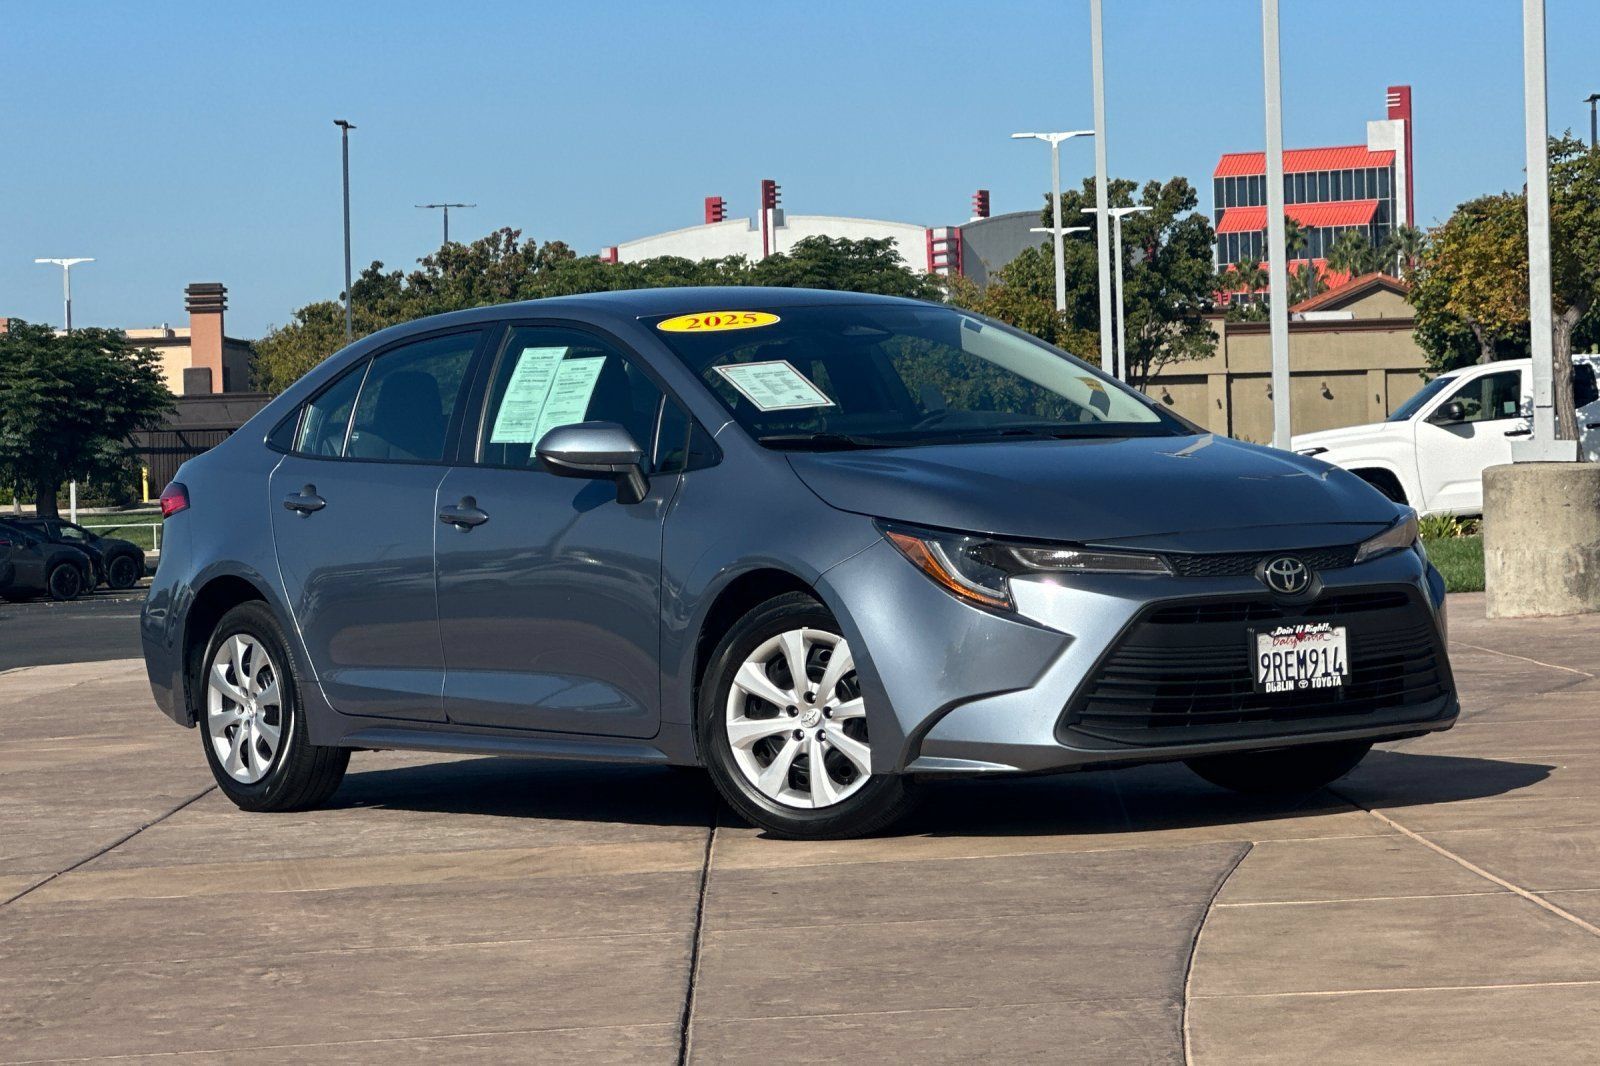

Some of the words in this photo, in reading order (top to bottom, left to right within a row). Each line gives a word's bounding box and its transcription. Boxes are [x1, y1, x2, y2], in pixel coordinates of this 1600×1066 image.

[685, 313, 758, 330] 2025
[1272, 632, 1331, 649] Califrnia
[1260, 646, 1343, 683] 9REM914
[1265, 680, 1294, 693] DUBLIN
[1311, 675, 1342, 689] TOYOTA
